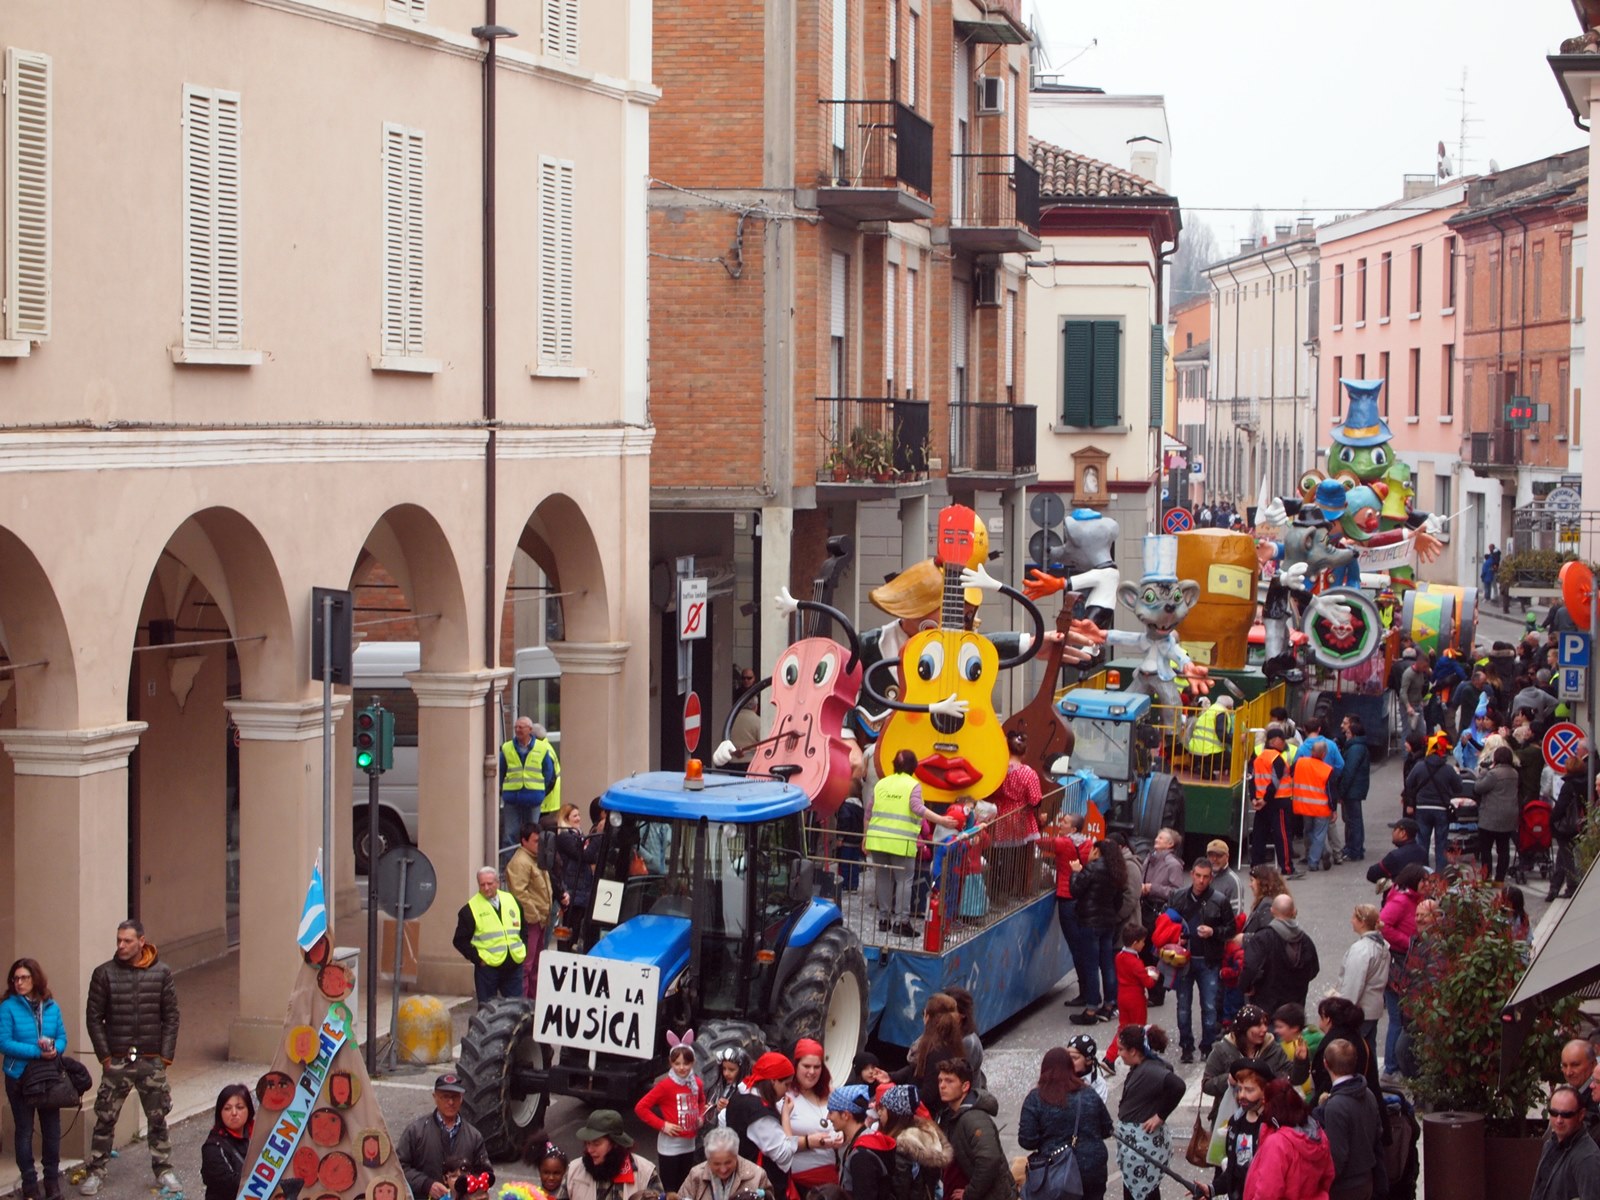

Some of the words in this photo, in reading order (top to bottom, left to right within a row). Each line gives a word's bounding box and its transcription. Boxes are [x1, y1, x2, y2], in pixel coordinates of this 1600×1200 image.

[1564, 635, 1584, 663] P
[603, 890, 613, 907] 2
[625, 988, 644, 1005] LA
